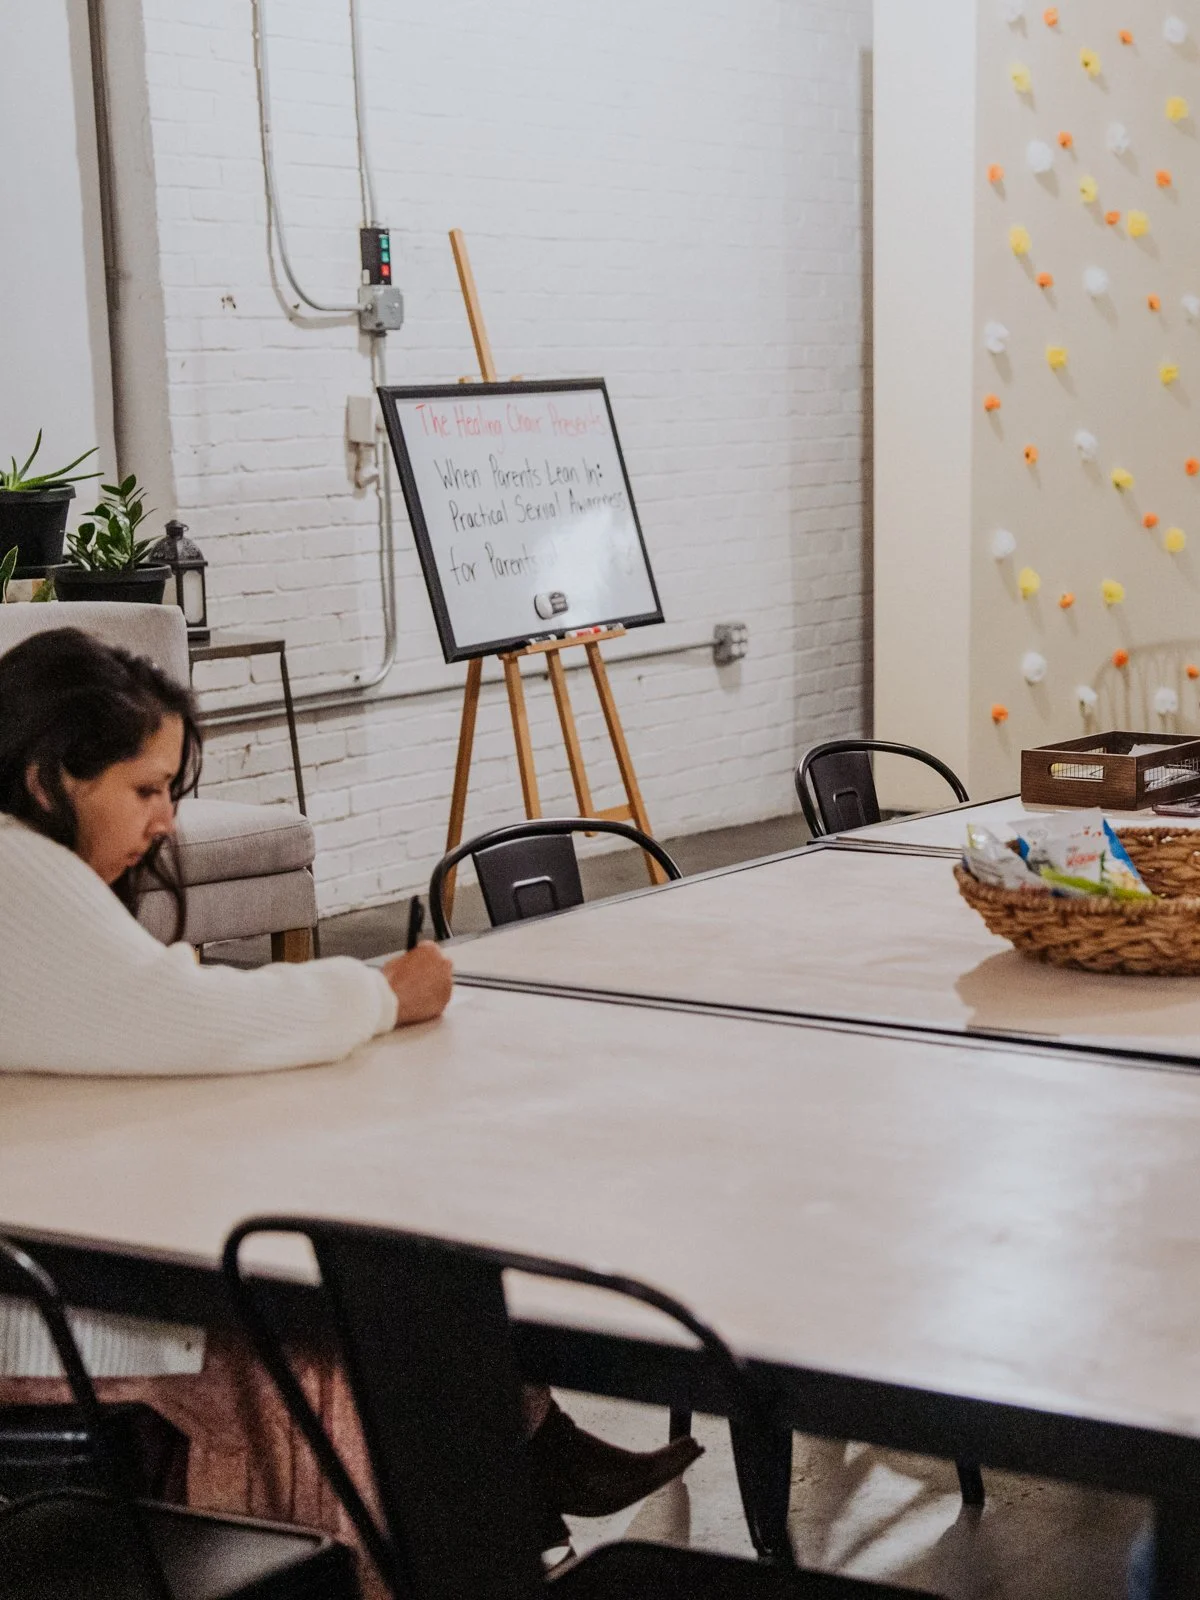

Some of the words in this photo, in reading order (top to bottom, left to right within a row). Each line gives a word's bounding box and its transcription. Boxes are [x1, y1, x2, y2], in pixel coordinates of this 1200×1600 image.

[415, 402, 451, 438] The
[454, 403, 504, 454] Healing
[433, 459, 482, 490] When
[488, 453, 542, 489] Parents
[545, 459, 580, 486] Lean
[582, 457, 603, 487] In:
[448, 500, 508, 532] Practical
[514, 491, 561, 524] Sexual
[450, 546, 476, 585] for
